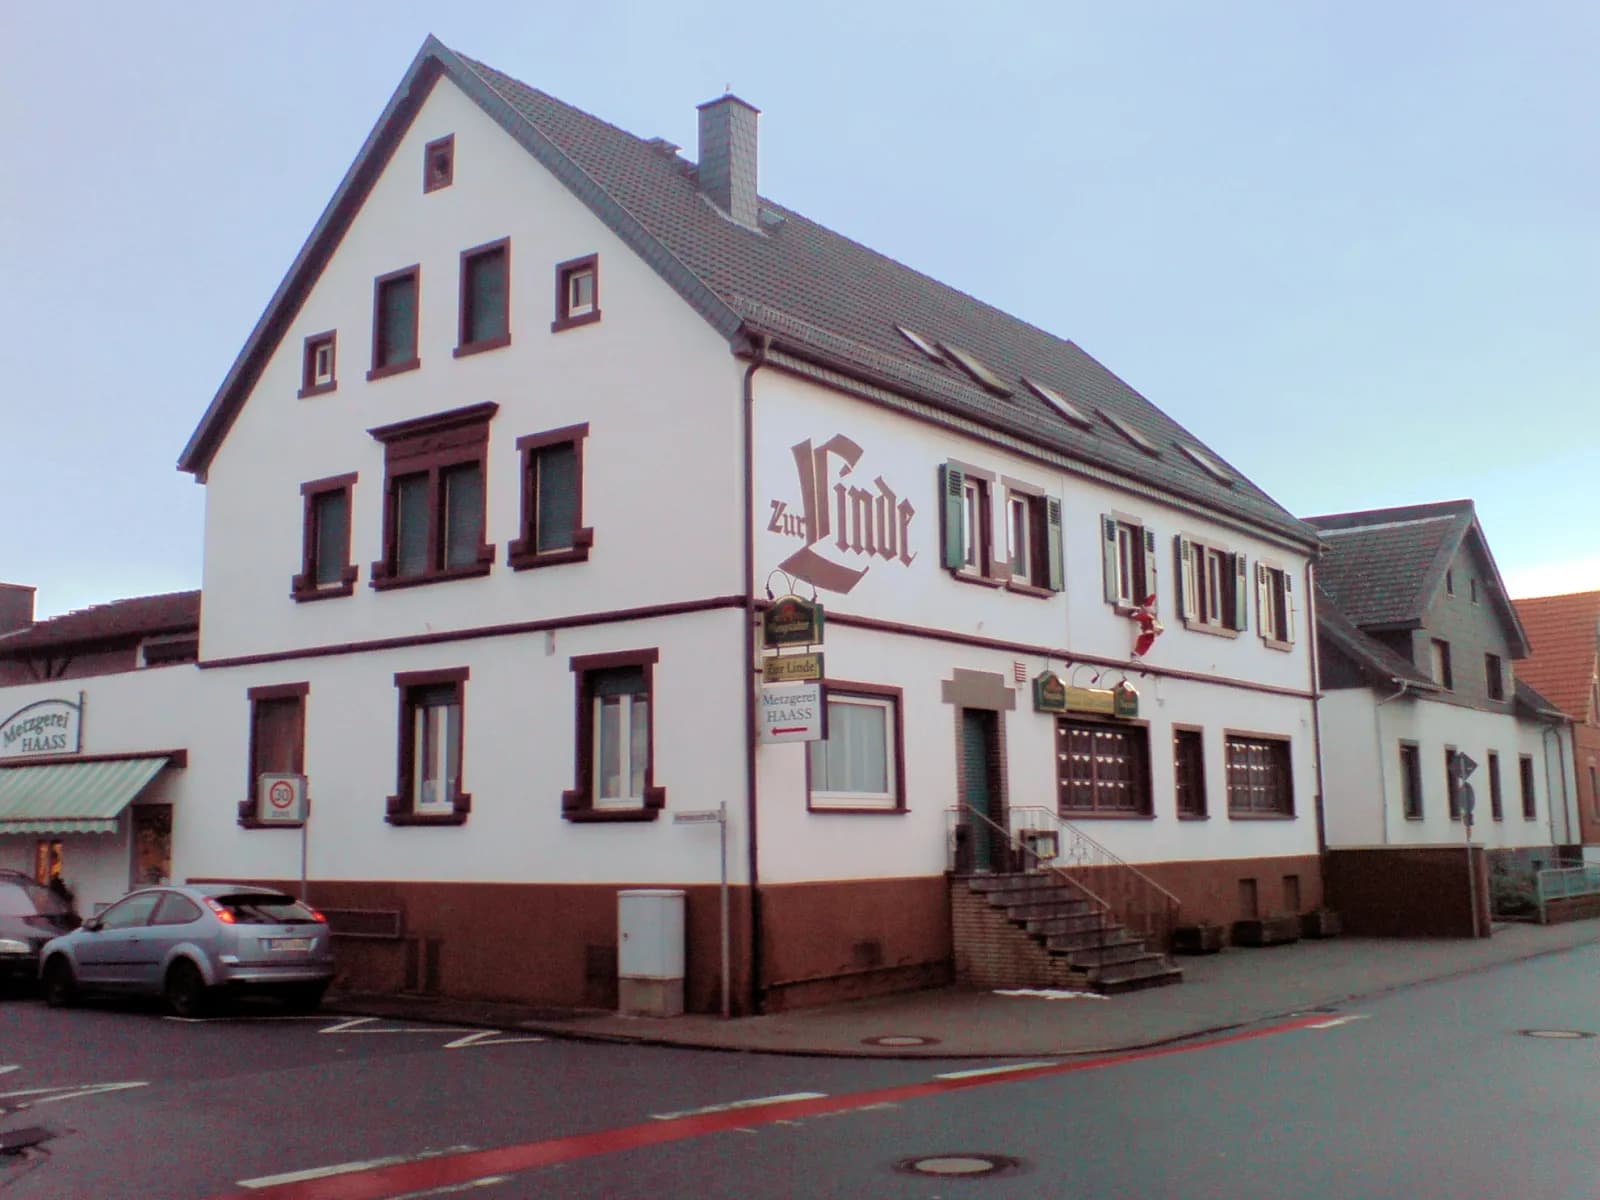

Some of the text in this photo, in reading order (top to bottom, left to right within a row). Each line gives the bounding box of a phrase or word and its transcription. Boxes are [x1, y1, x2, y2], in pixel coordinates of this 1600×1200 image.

[767, 433, 918, 595] Zur Linde
[787, 659, 815, 674] Linde
[762, 690, 817, 707] Metzgerei
[767, 708, 813, 724] HAASS
[3, 711, 70, 748] Metzgerei
[22, 733, 67, 753] HAASS
[275, 787, 290, 802] 30
